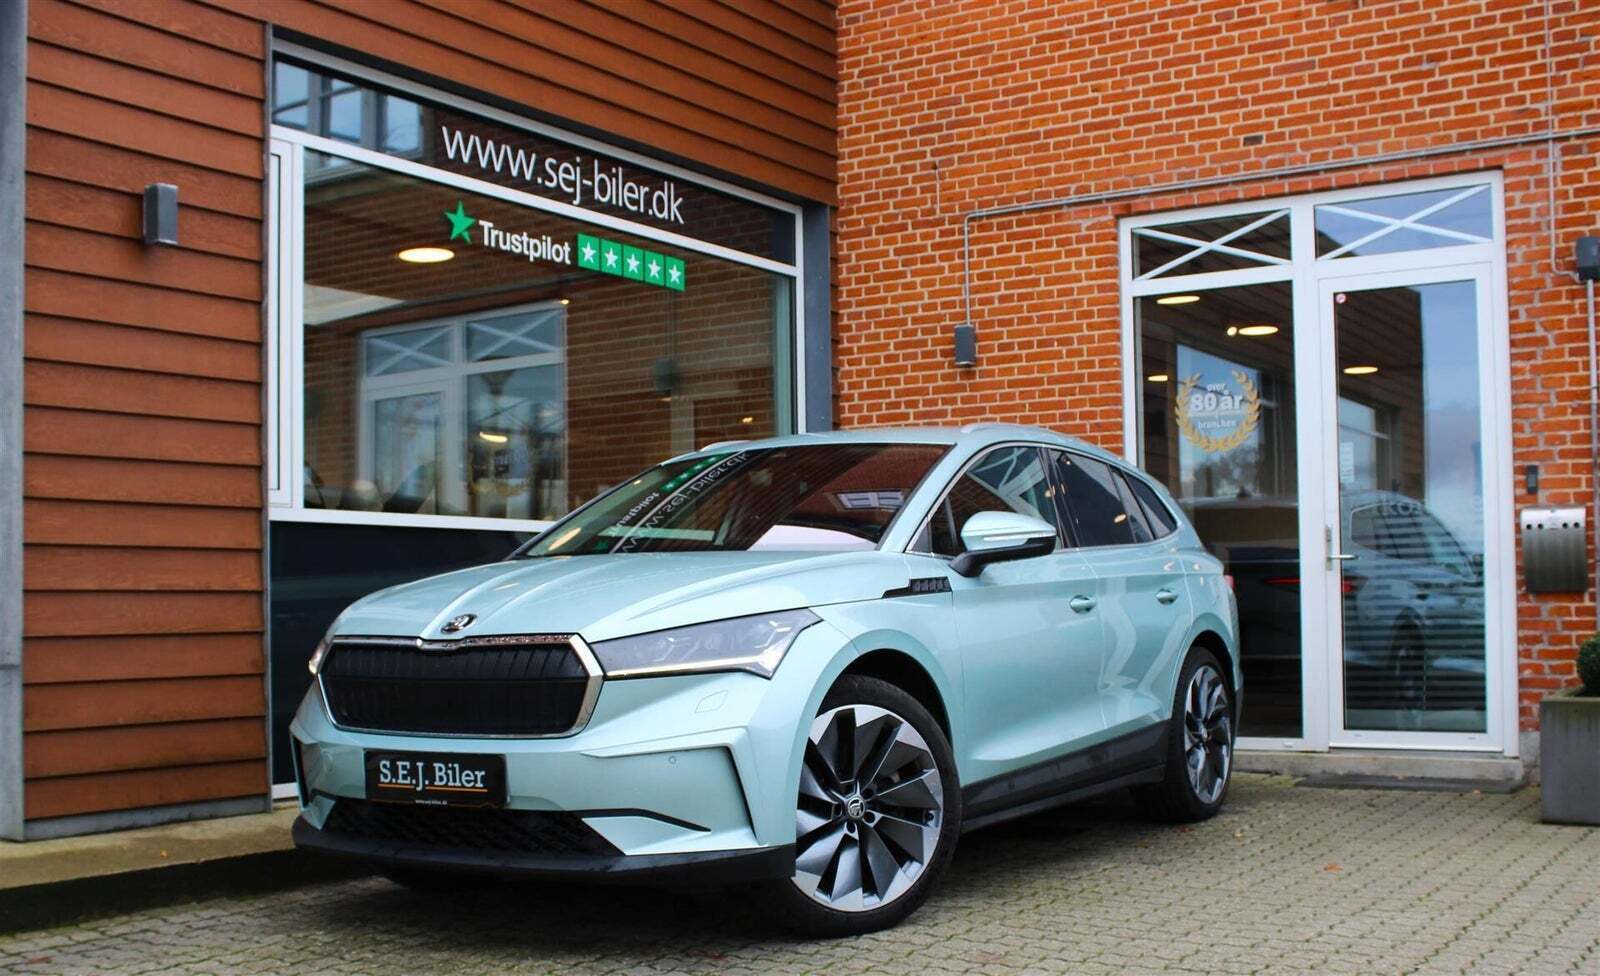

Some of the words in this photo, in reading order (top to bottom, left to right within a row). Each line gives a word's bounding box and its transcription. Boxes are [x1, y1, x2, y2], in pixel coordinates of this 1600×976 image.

[441, 126, 685, 225] www.sej-biler.dk
[478, 220, 571, 265] Trustpilot
[1190, 393, 1217, 411] 80
[1220, 390, 1243, 410] år
[379, 760, 429, 791] S.E.J.
[433, 763, 486, 788] Biler
